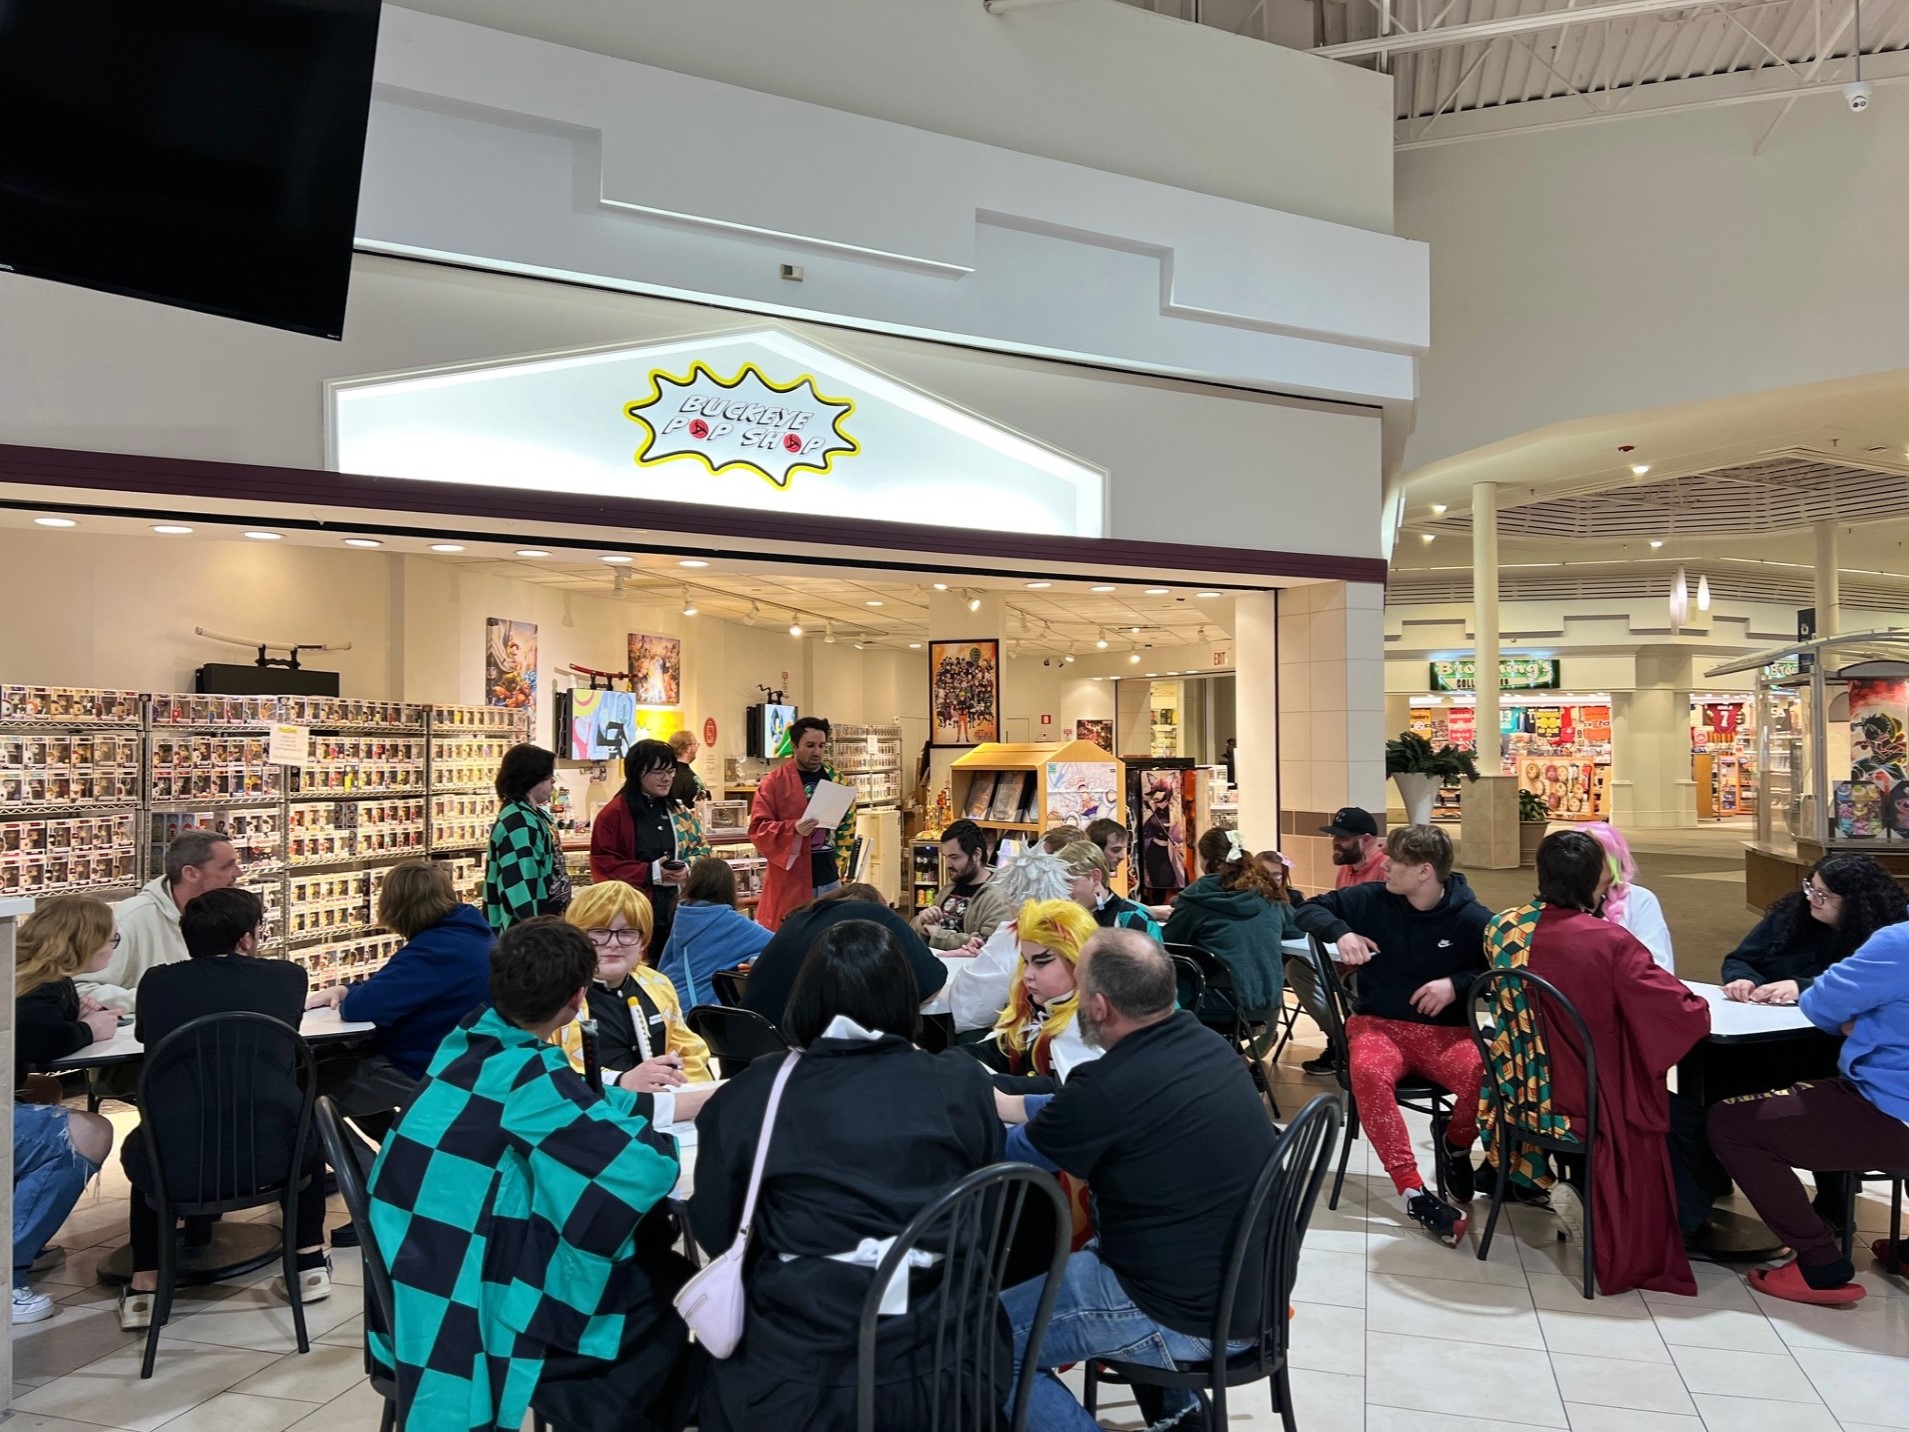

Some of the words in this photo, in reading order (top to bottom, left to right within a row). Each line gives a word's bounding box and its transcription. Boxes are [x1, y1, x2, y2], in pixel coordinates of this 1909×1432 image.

[679, 395, 815, 430] BUCKEYE
[661, 416, 734, 441] POP
[741, 427, 825, 455] SHOP
[1435, 660, 1553, 681] Broing's
[1720, 711, 1728, 727] 7
